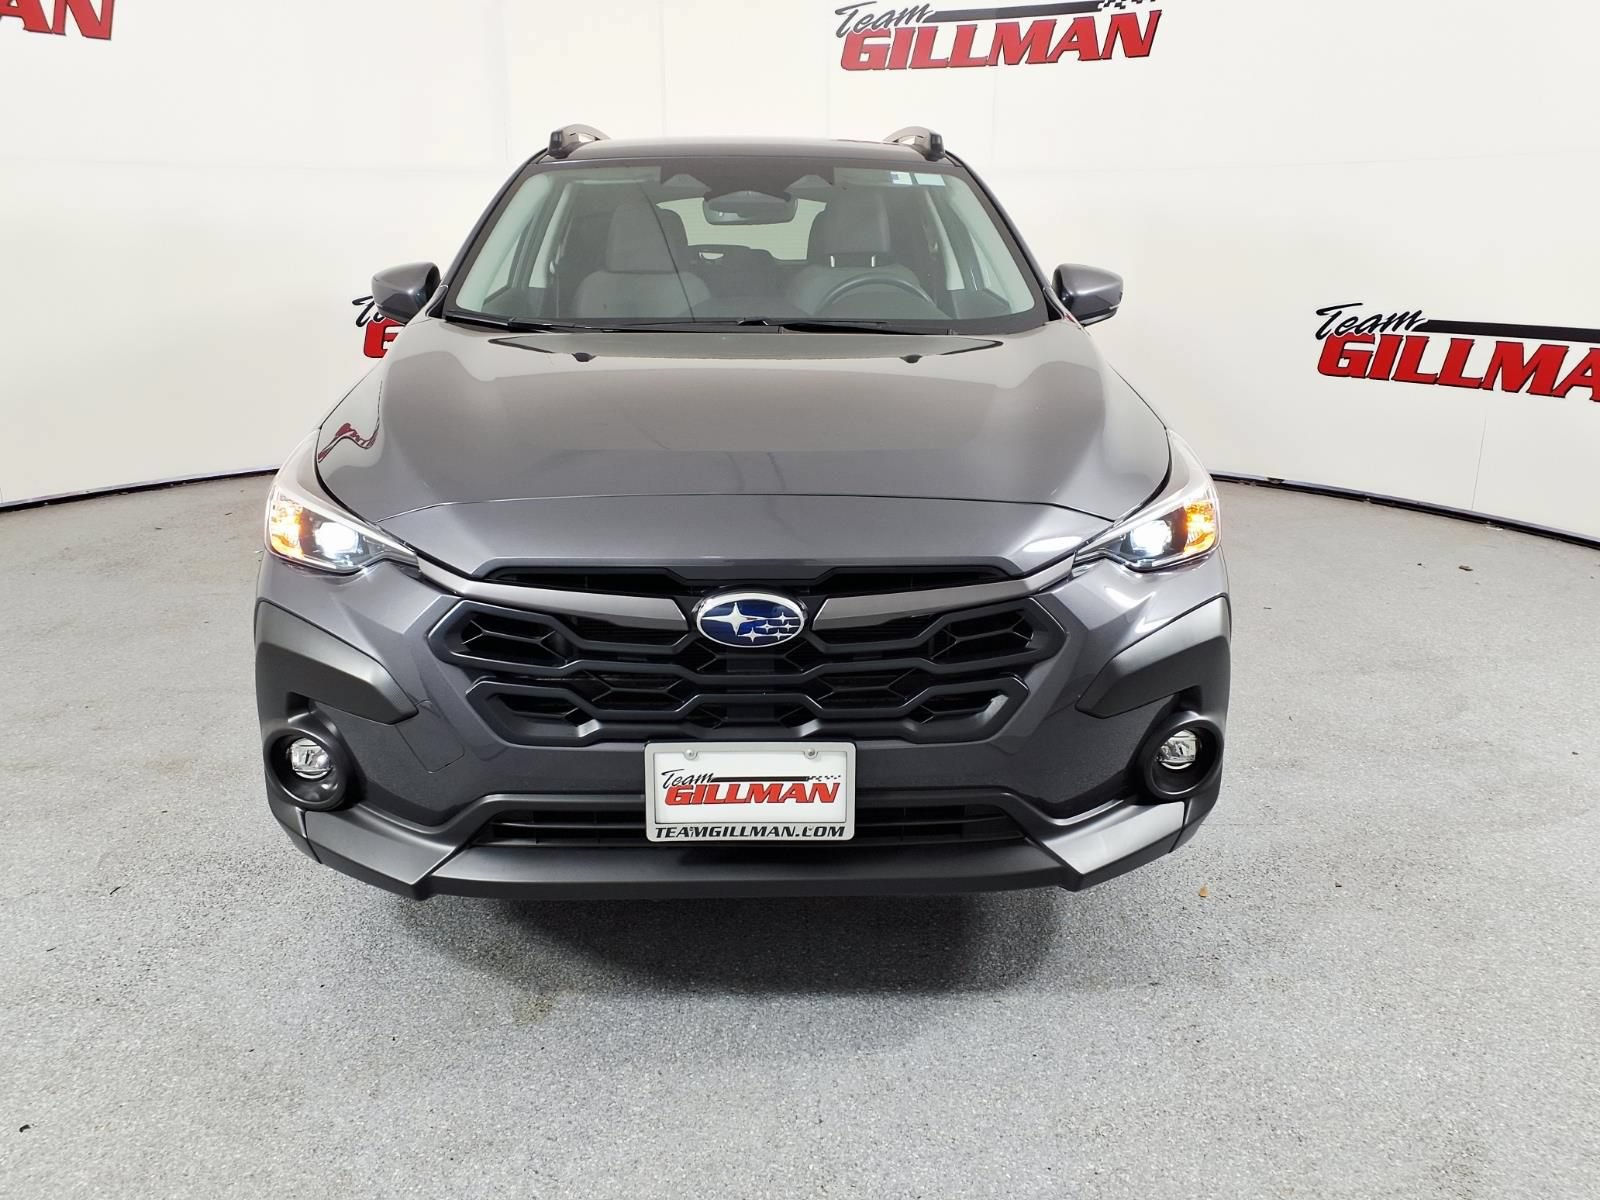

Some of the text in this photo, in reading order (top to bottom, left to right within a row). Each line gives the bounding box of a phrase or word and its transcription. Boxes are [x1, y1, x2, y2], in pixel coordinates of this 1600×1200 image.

[834, 1, 938, 38] Team
[841, 10, 1162, 71] GILLMAN
[1315, 302, 1426, 340] Team
[661, 768, 714, 789] Team
[665, 782, 840, 806] GILLMAN
[655, 825, 845, 839] TEAMGILLMAN.COM
